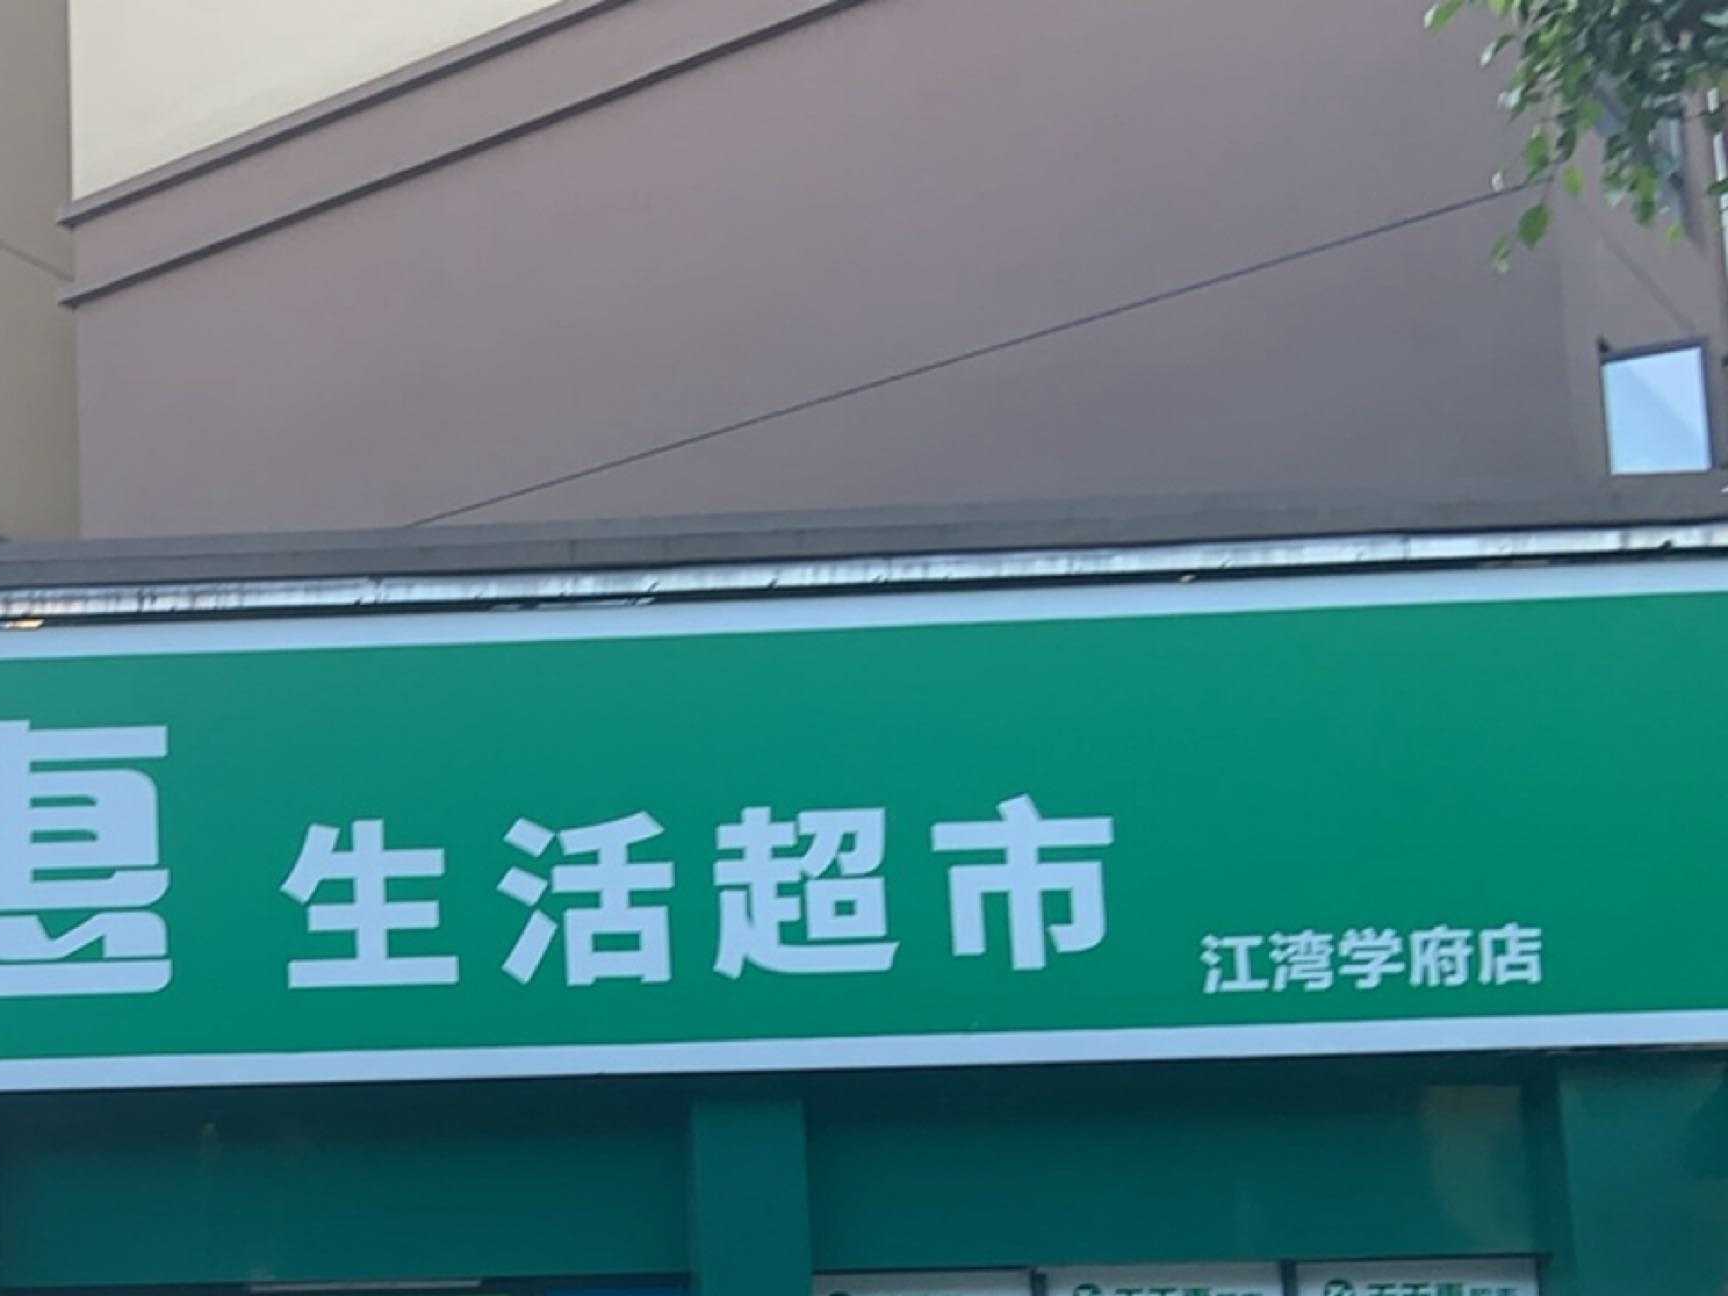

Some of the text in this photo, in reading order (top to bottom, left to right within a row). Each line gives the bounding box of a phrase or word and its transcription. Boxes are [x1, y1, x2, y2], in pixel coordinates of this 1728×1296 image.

[279, 793, 1115, 989] 生活超市
[1200, 921, 1544, 994] 江湾学府店
